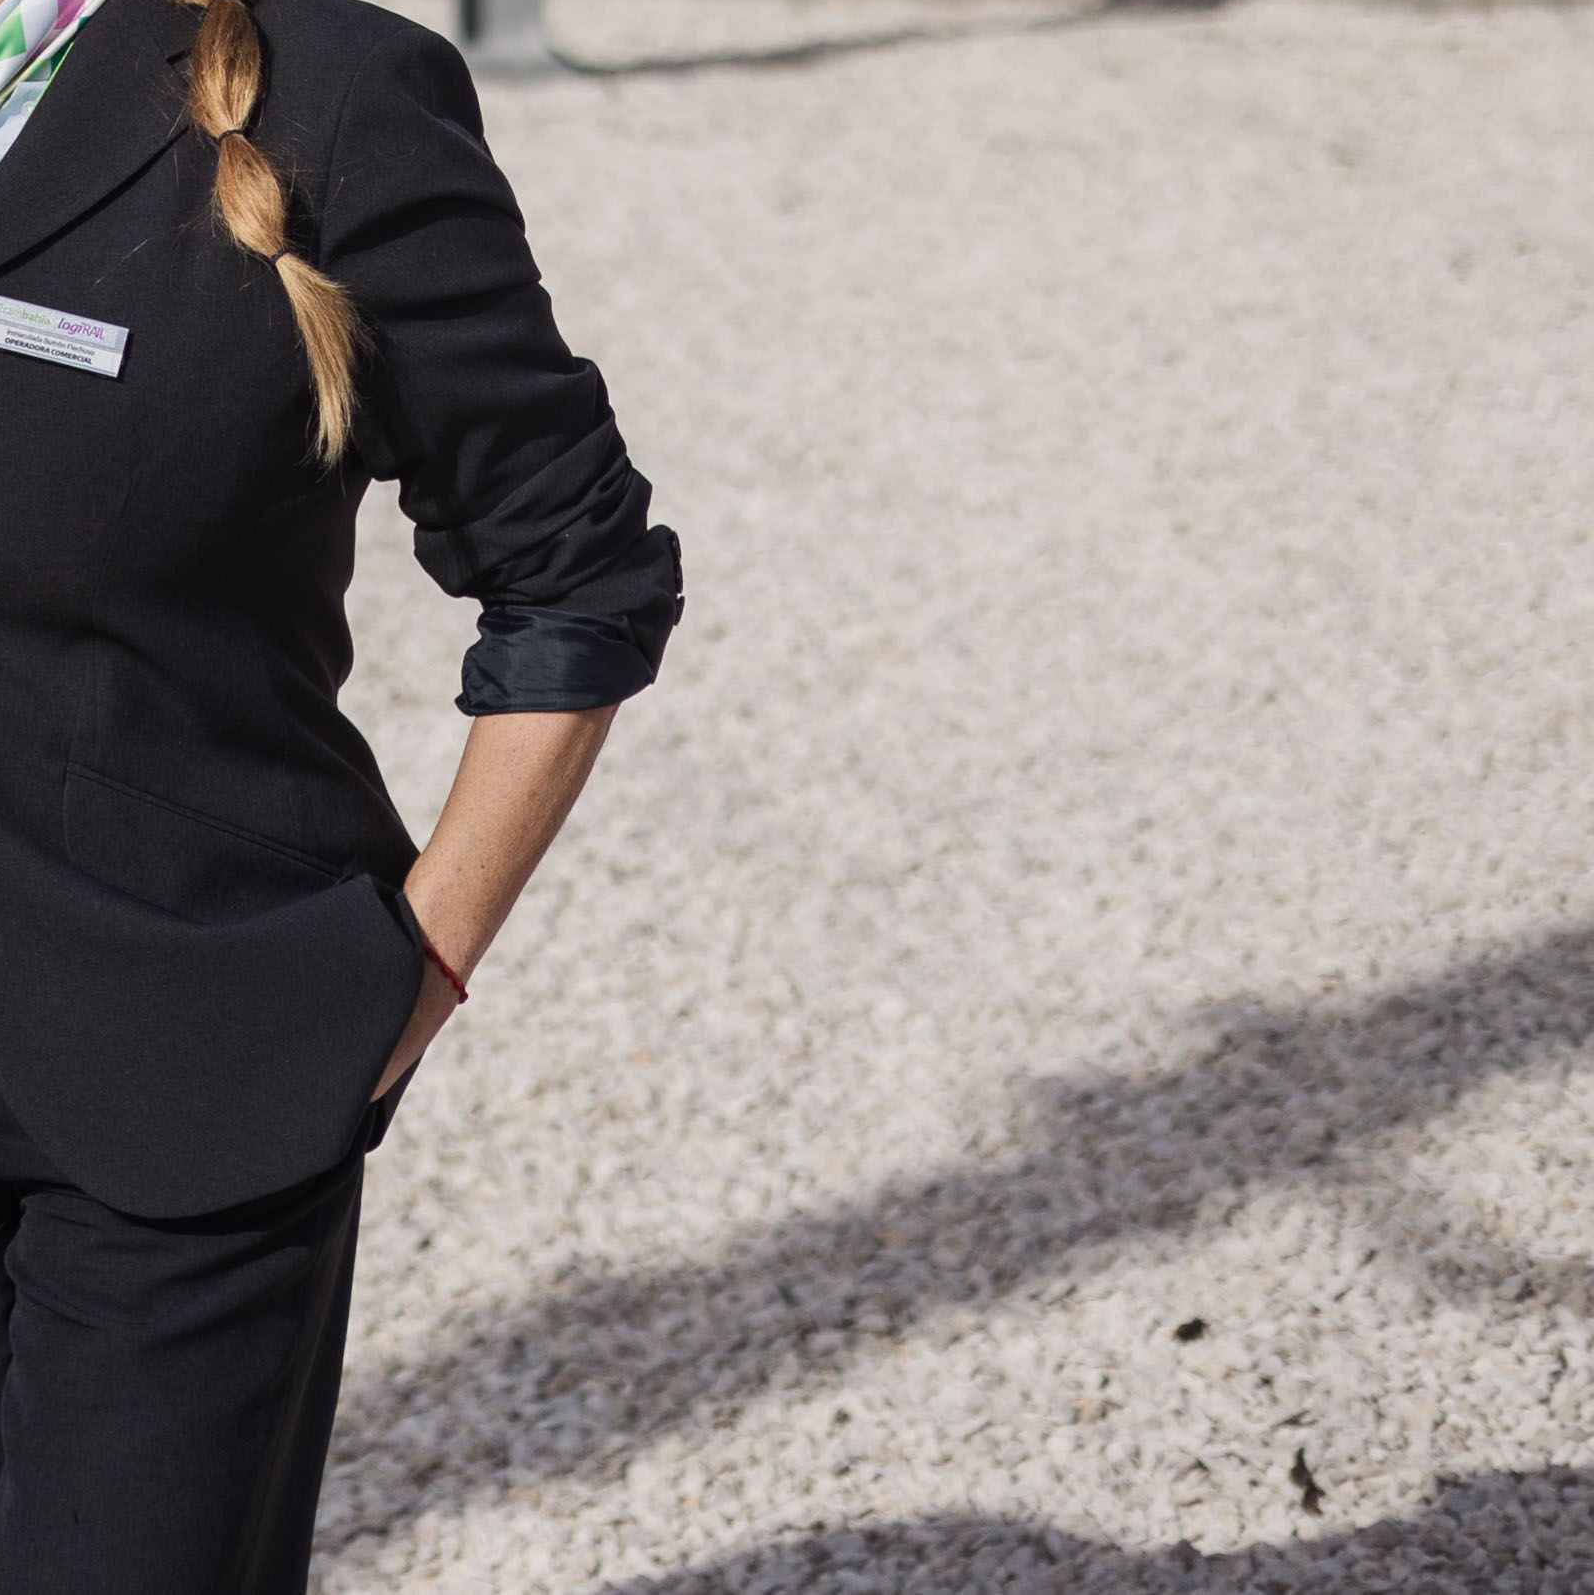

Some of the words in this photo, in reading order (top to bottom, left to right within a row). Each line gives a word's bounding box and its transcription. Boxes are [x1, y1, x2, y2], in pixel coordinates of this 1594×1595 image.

[57, 317, 106, 340] logiRAIL
[4, 337, 50, 354] OPERADORA
[50, 349, 93, 364] COMERCIAL
